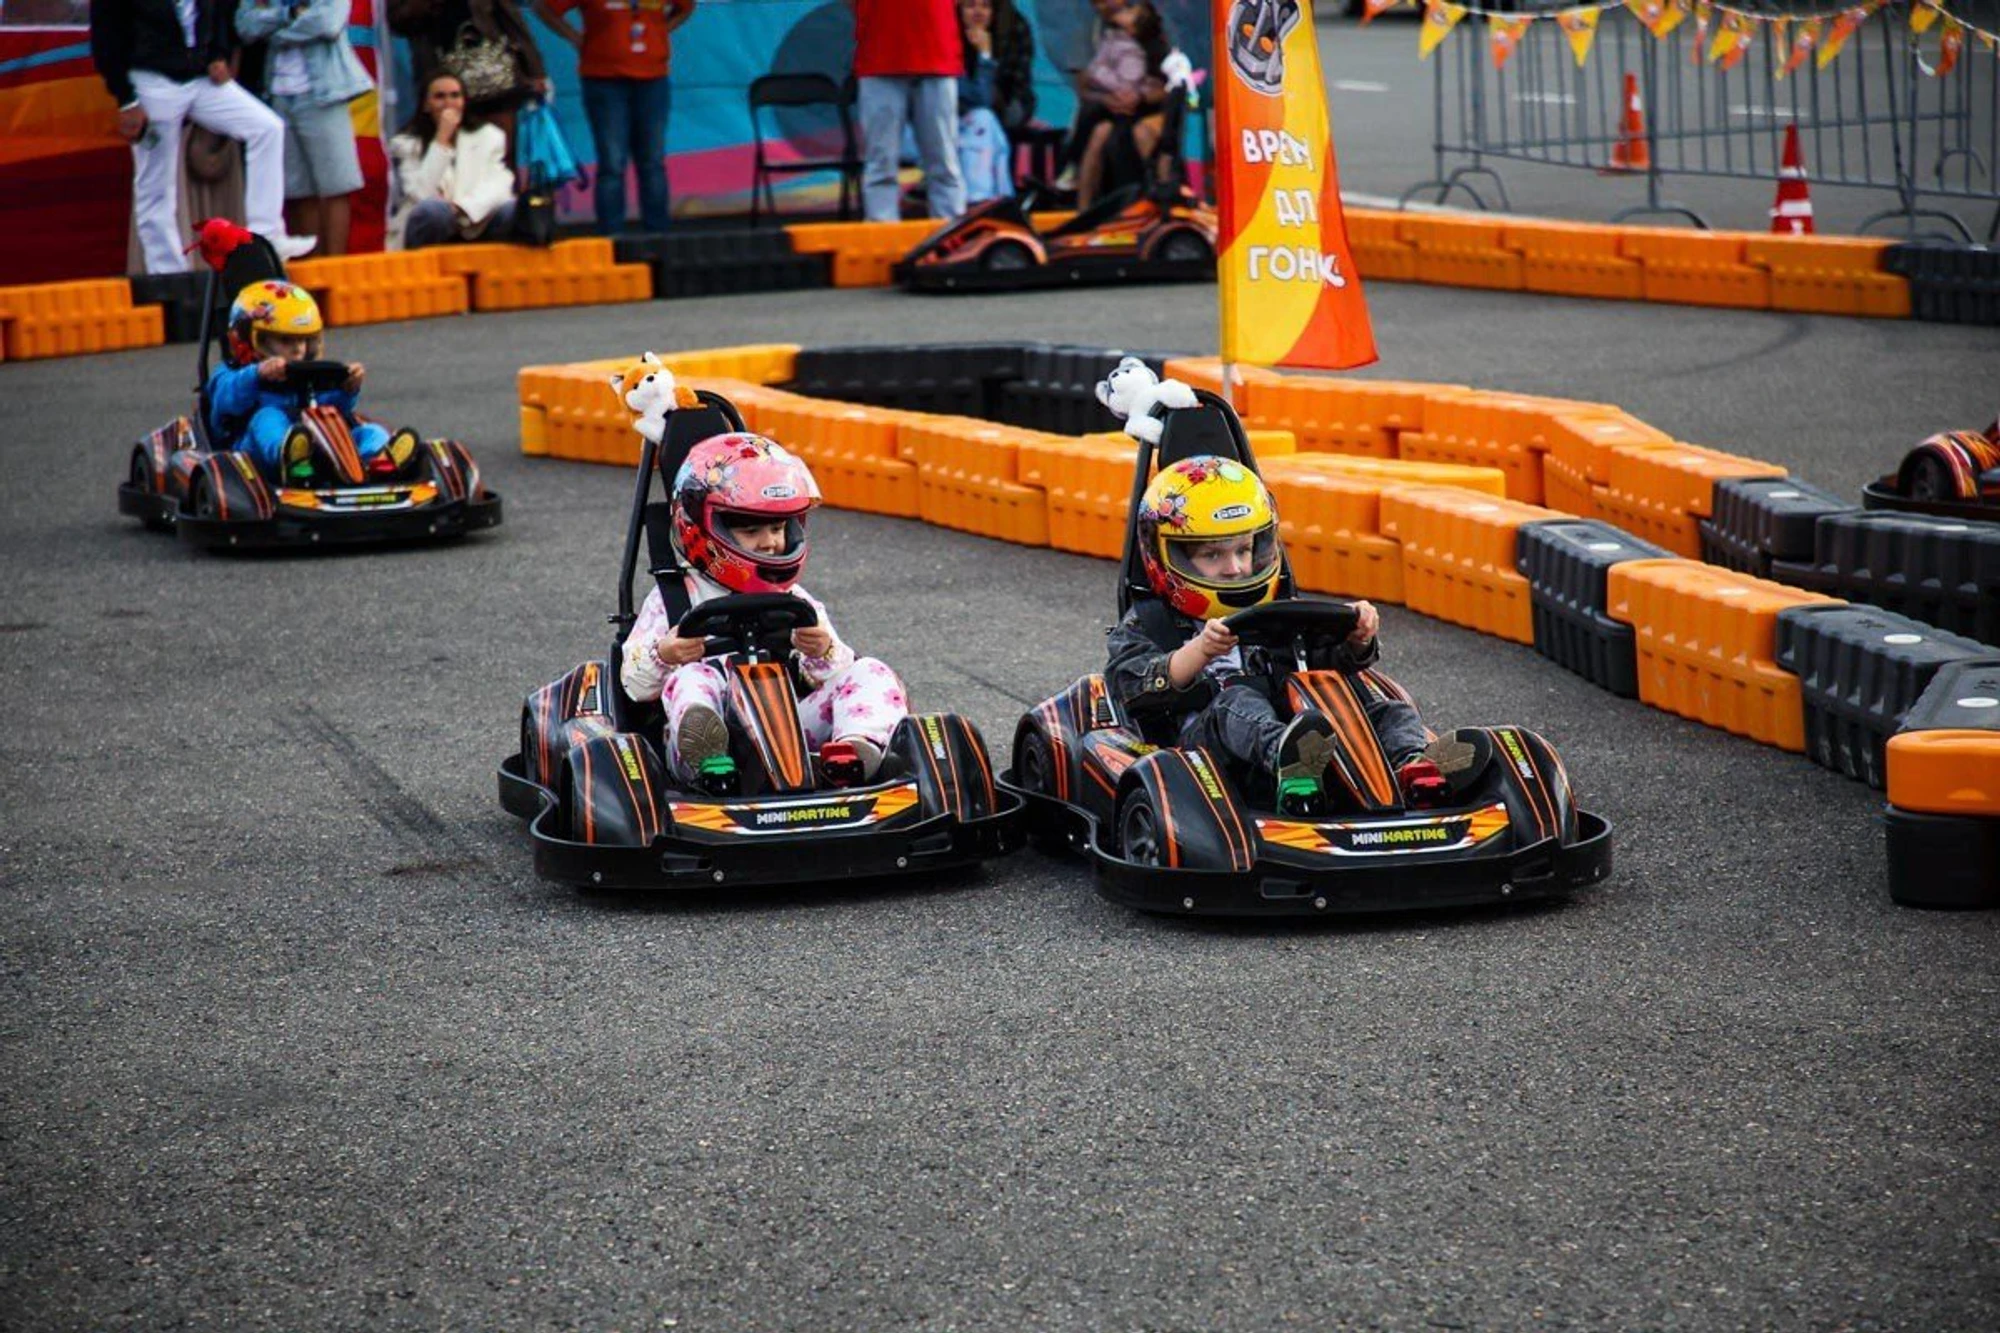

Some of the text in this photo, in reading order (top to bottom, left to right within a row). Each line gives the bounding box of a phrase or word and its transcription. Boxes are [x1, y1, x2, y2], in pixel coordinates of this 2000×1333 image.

[1249, 246, 1346, 288] ГОНК
[756, 806, 850, 825] MINIKARTING
[1351, 828, 1448, 846] MINIKARTING
